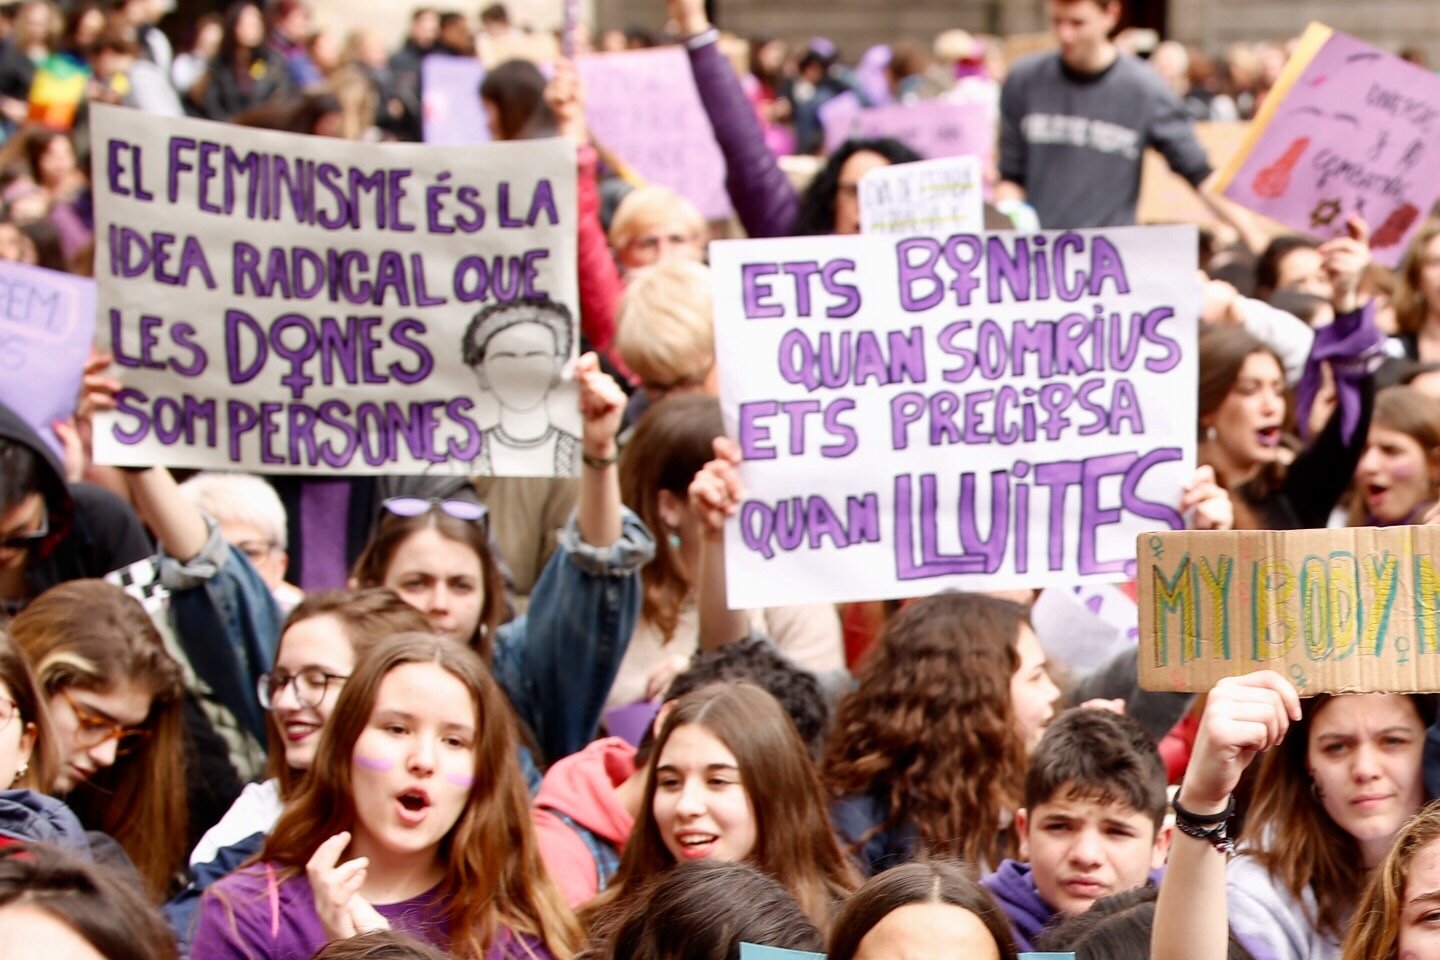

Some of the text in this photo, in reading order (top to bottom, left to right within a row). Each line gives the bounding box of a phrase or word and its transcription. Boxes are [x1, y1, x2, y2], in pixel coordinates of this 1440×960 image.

[107, 135, 560, 234] EL FEMINISME ÉS LA
[107, 224, 551, 308] IDEA RADICAL QUE
[741, 258, 862, 319] ETS
[109, 307, 209, 379] LES
[778, 326, 927, 392] QUAN
[111, 388, 484, 468] SOM PERSONES
[739, 399, 859, 460] ETS
[740, 492, 881, 559] QUAN
[1153, 552, 1234, 668] MY
[1251, 550, 1398, 662] BODY
